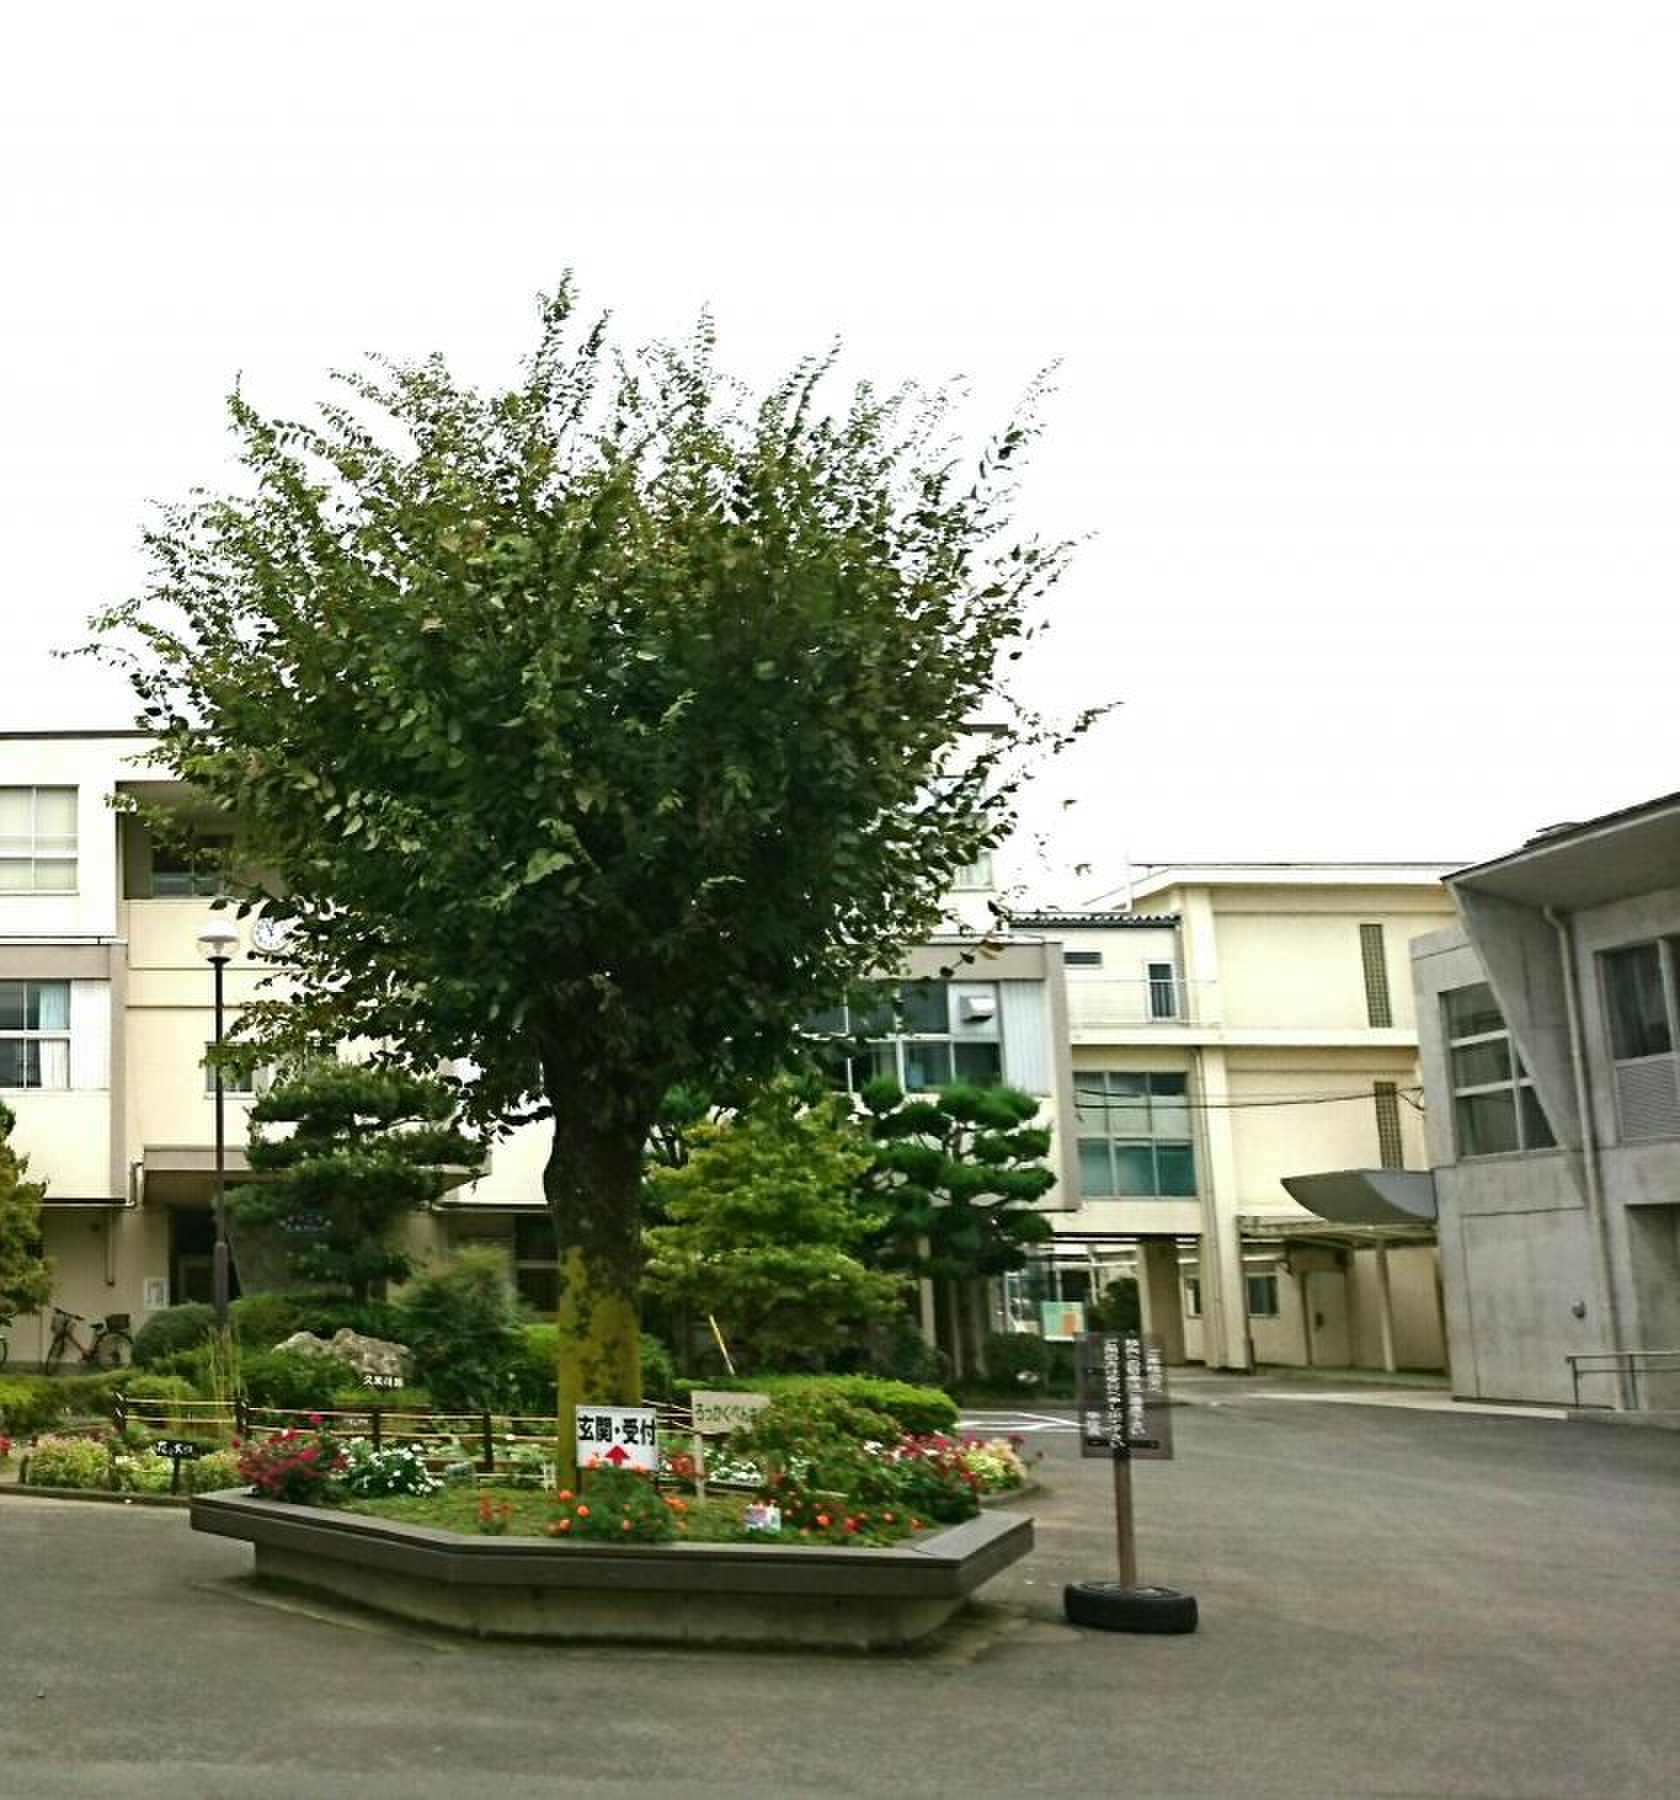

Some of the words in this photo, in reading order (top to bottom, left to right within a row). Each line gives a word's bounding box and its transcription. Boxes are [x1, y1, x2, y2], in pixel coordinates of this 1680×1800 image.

[577, 1415, 656, 1446] 玄関・受付
